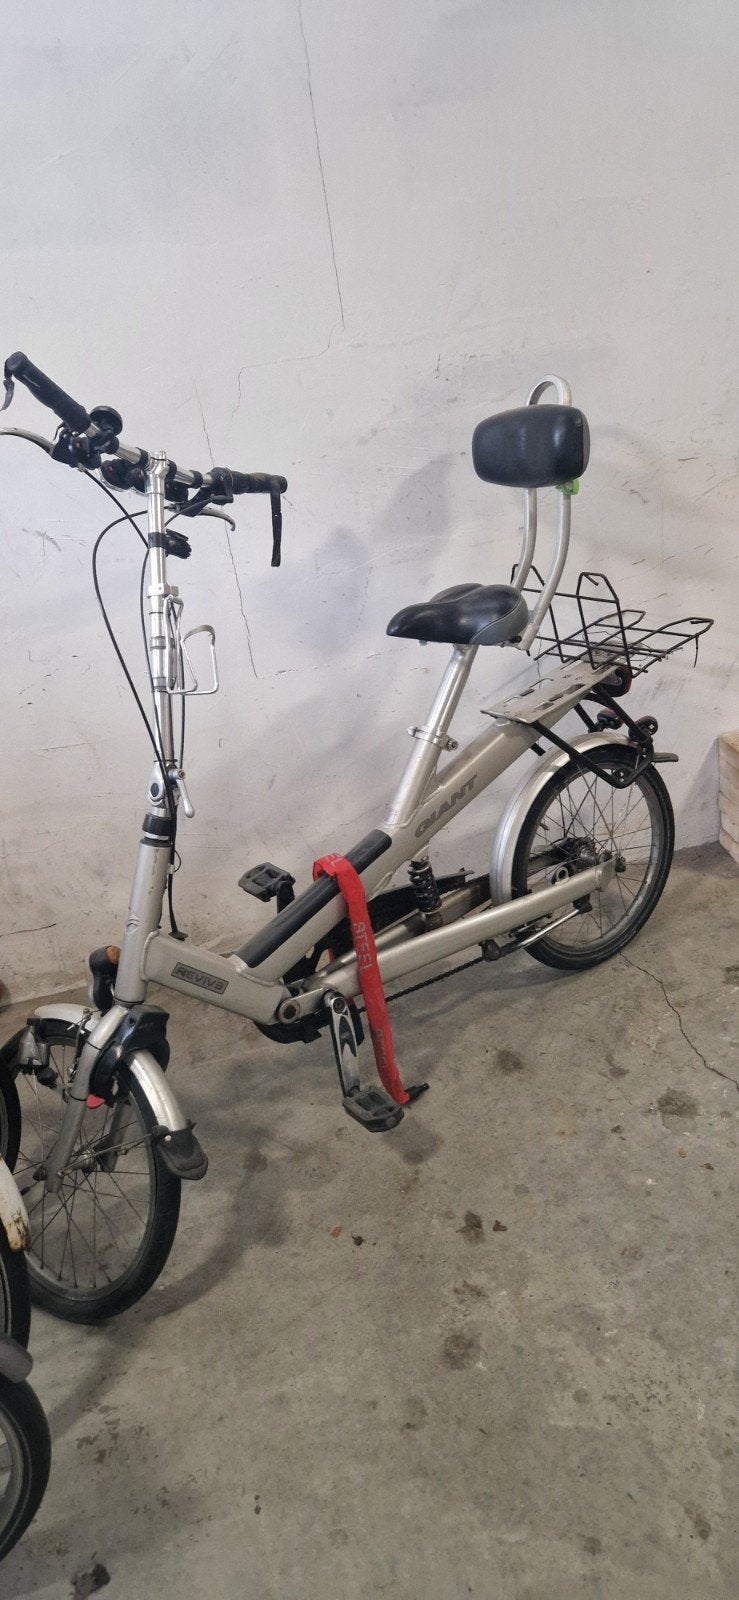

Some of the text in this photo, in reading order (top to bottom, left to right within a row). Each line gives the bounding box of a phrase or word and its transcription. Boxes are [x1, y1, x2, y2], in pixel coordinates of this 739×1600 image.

[415, 773, 477, 838] GIANT
[353, 921, 373, 969] STEEL
[175, 966, 225, 991] REVIVE
